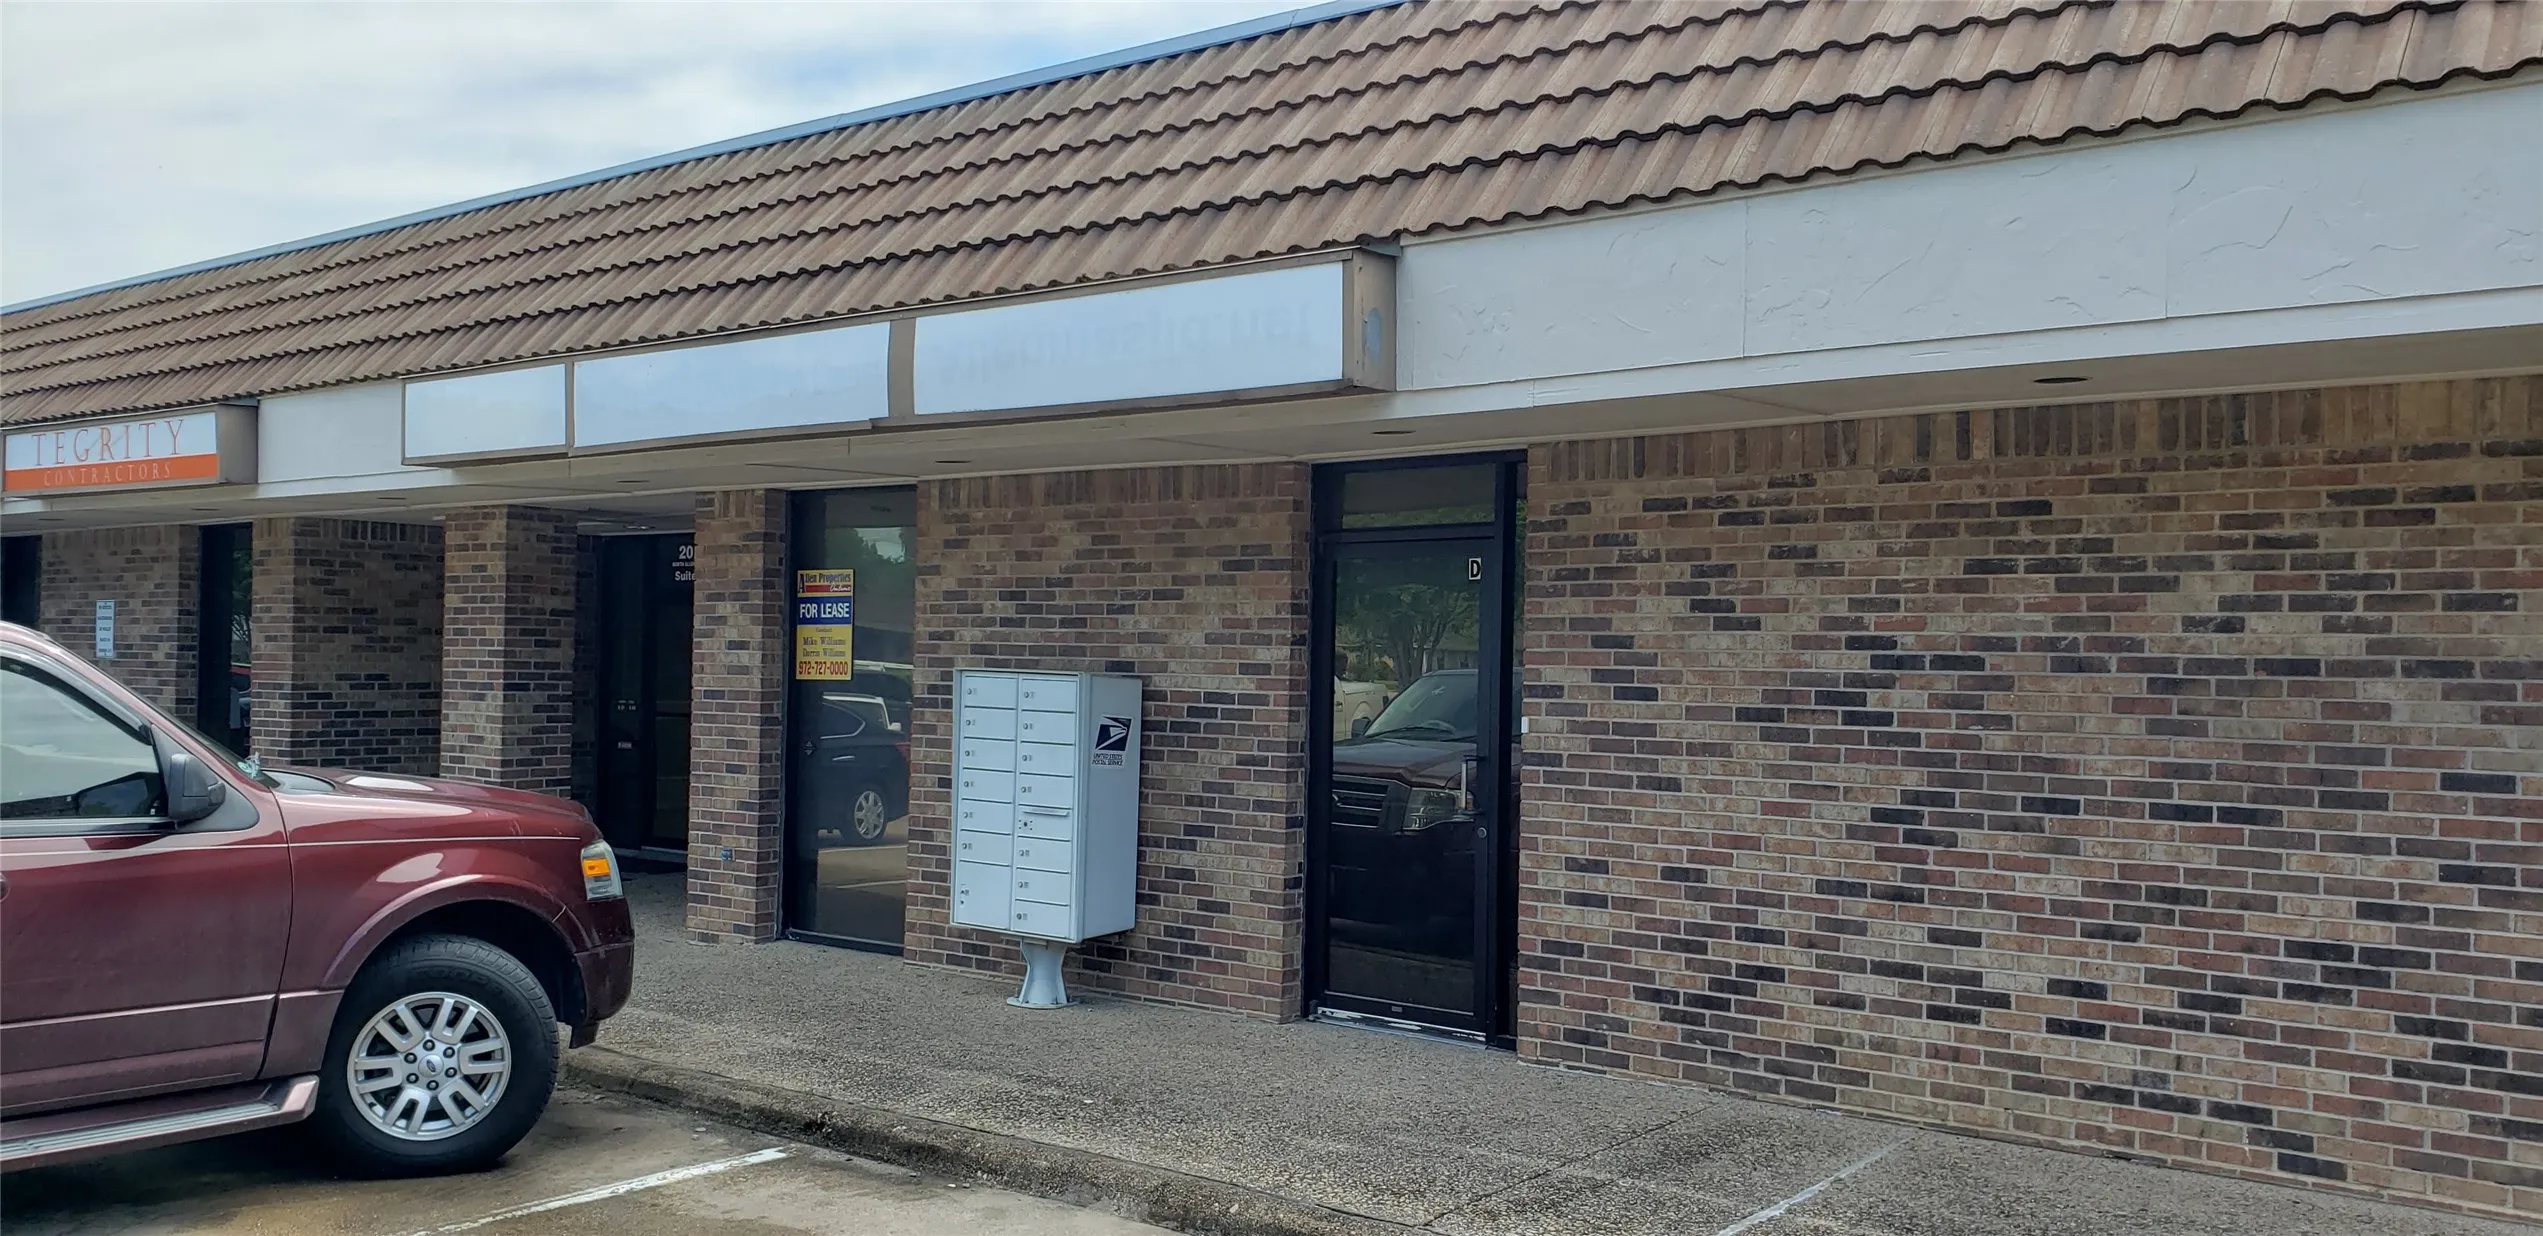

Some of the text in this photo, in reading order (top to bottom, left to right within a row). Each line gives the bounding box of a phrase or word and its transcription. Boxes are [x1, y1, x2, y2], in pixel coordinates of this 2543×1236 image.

[32, 419, 183, 466] TEGRITY
[44, 462, 171, 487] CONTRACTORS
[1470, 559, 1481, 578] D
[800, 603, 850, 618] FOR LEASE
[799, 661, 849, 676] 972-727-0000
